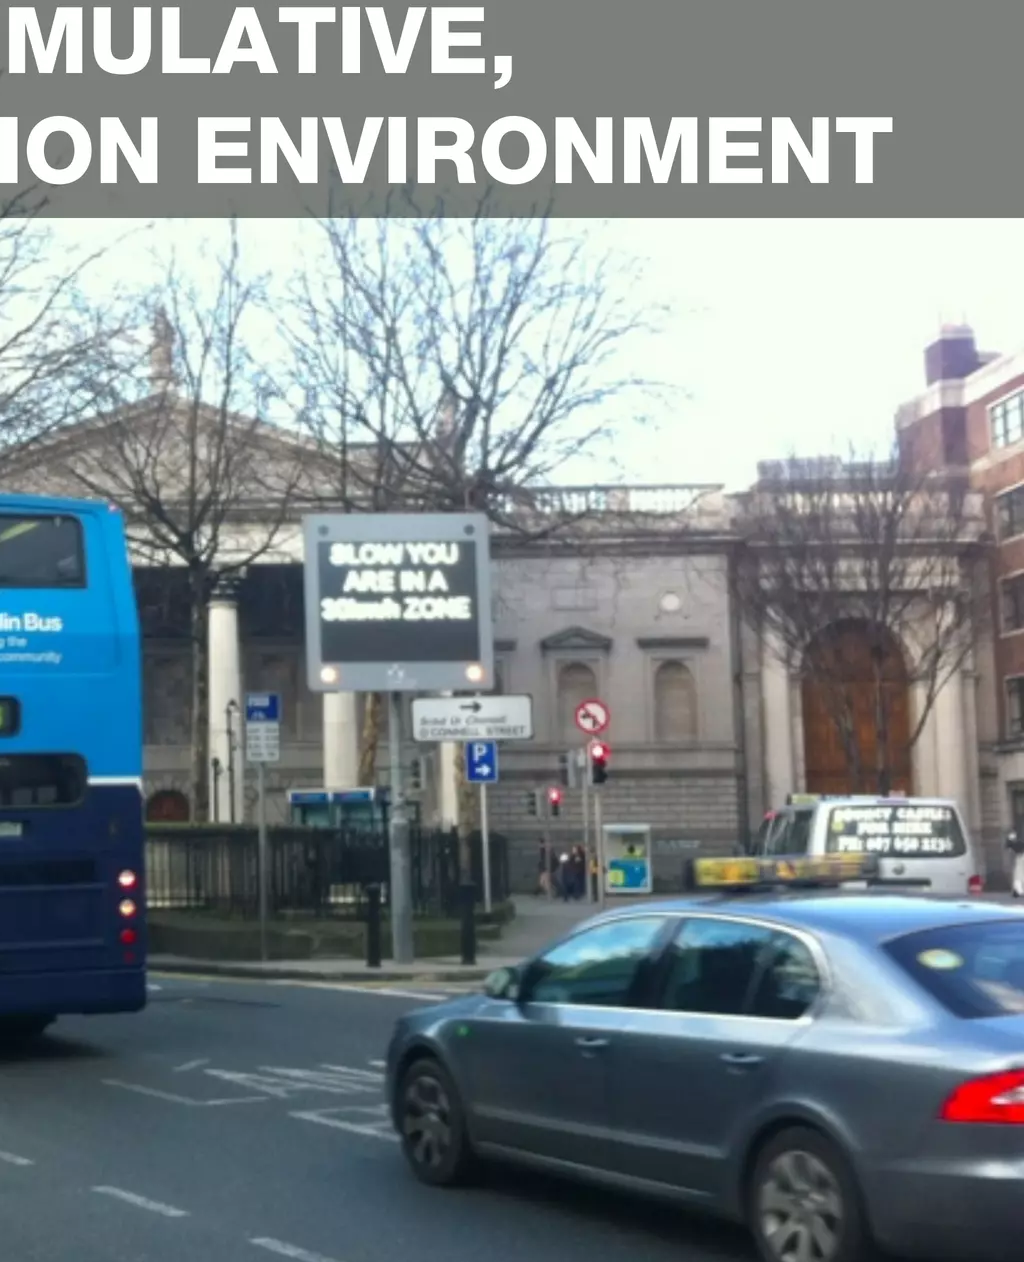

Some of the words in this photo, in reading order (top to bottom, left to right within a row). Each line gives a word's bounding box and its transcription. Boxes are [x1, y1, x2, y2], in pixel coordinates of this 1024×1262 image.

[405, 542, 459, 566] YOU
[342, 569, 396, 593] ARE
[399, 570, 426, 592] IN
[427, 569, 449, 592] A
[403, 596, 472, 620] ZONE
[23, 613, 63, 632] Bus
[7, 636, 27, 648] the
[473, 744, 487, 763] P
